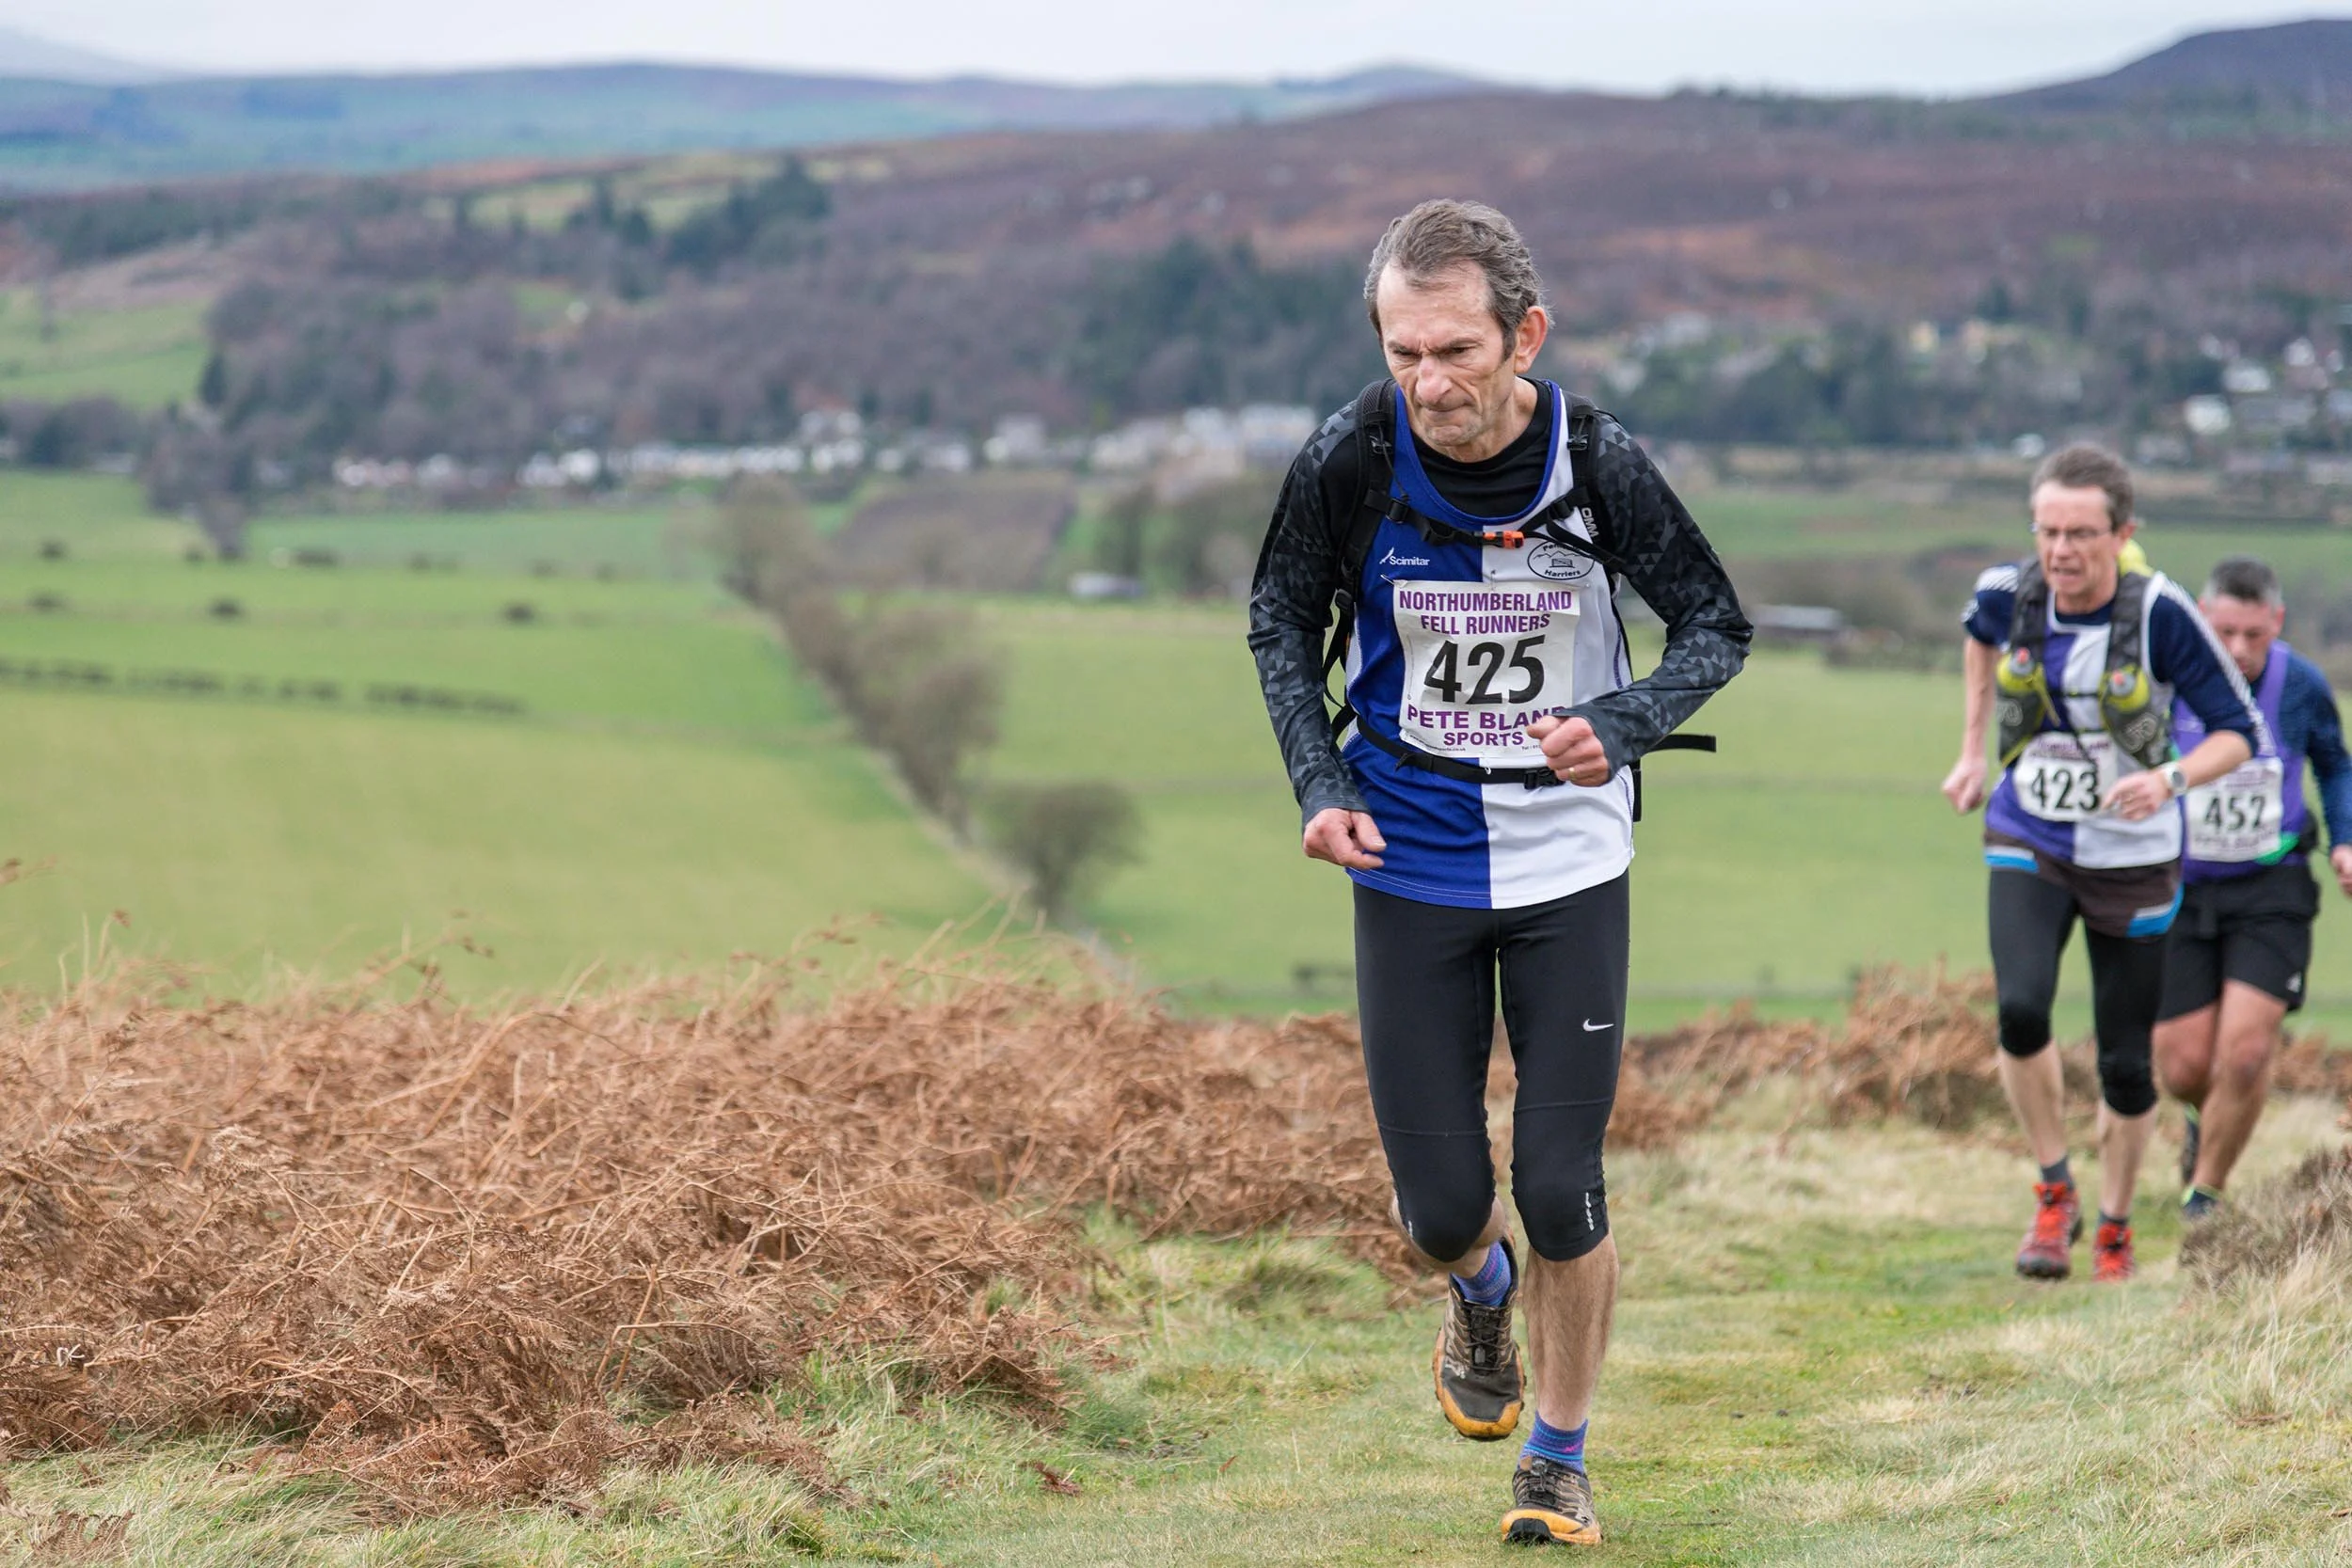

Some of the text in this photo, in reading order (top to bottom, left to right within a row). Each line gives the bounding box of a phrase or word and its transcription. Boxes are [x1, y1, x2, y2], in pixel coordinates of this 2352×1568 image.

[1390, 555, 1430, 565] Scimitar
[1544, 569, 1581, 578] Harriers
[1399, 591, 1572, 612] NORTHUMBERLAND
[1421, 613, 1550, 635] FELL RUNNERS
[1423, 634, 1546, 705] 425
[1407, 704, 1470, 729] PETE
[1443, 731, 1524, 747] SPORTS
[2032, 768, 2100, 812] 423
